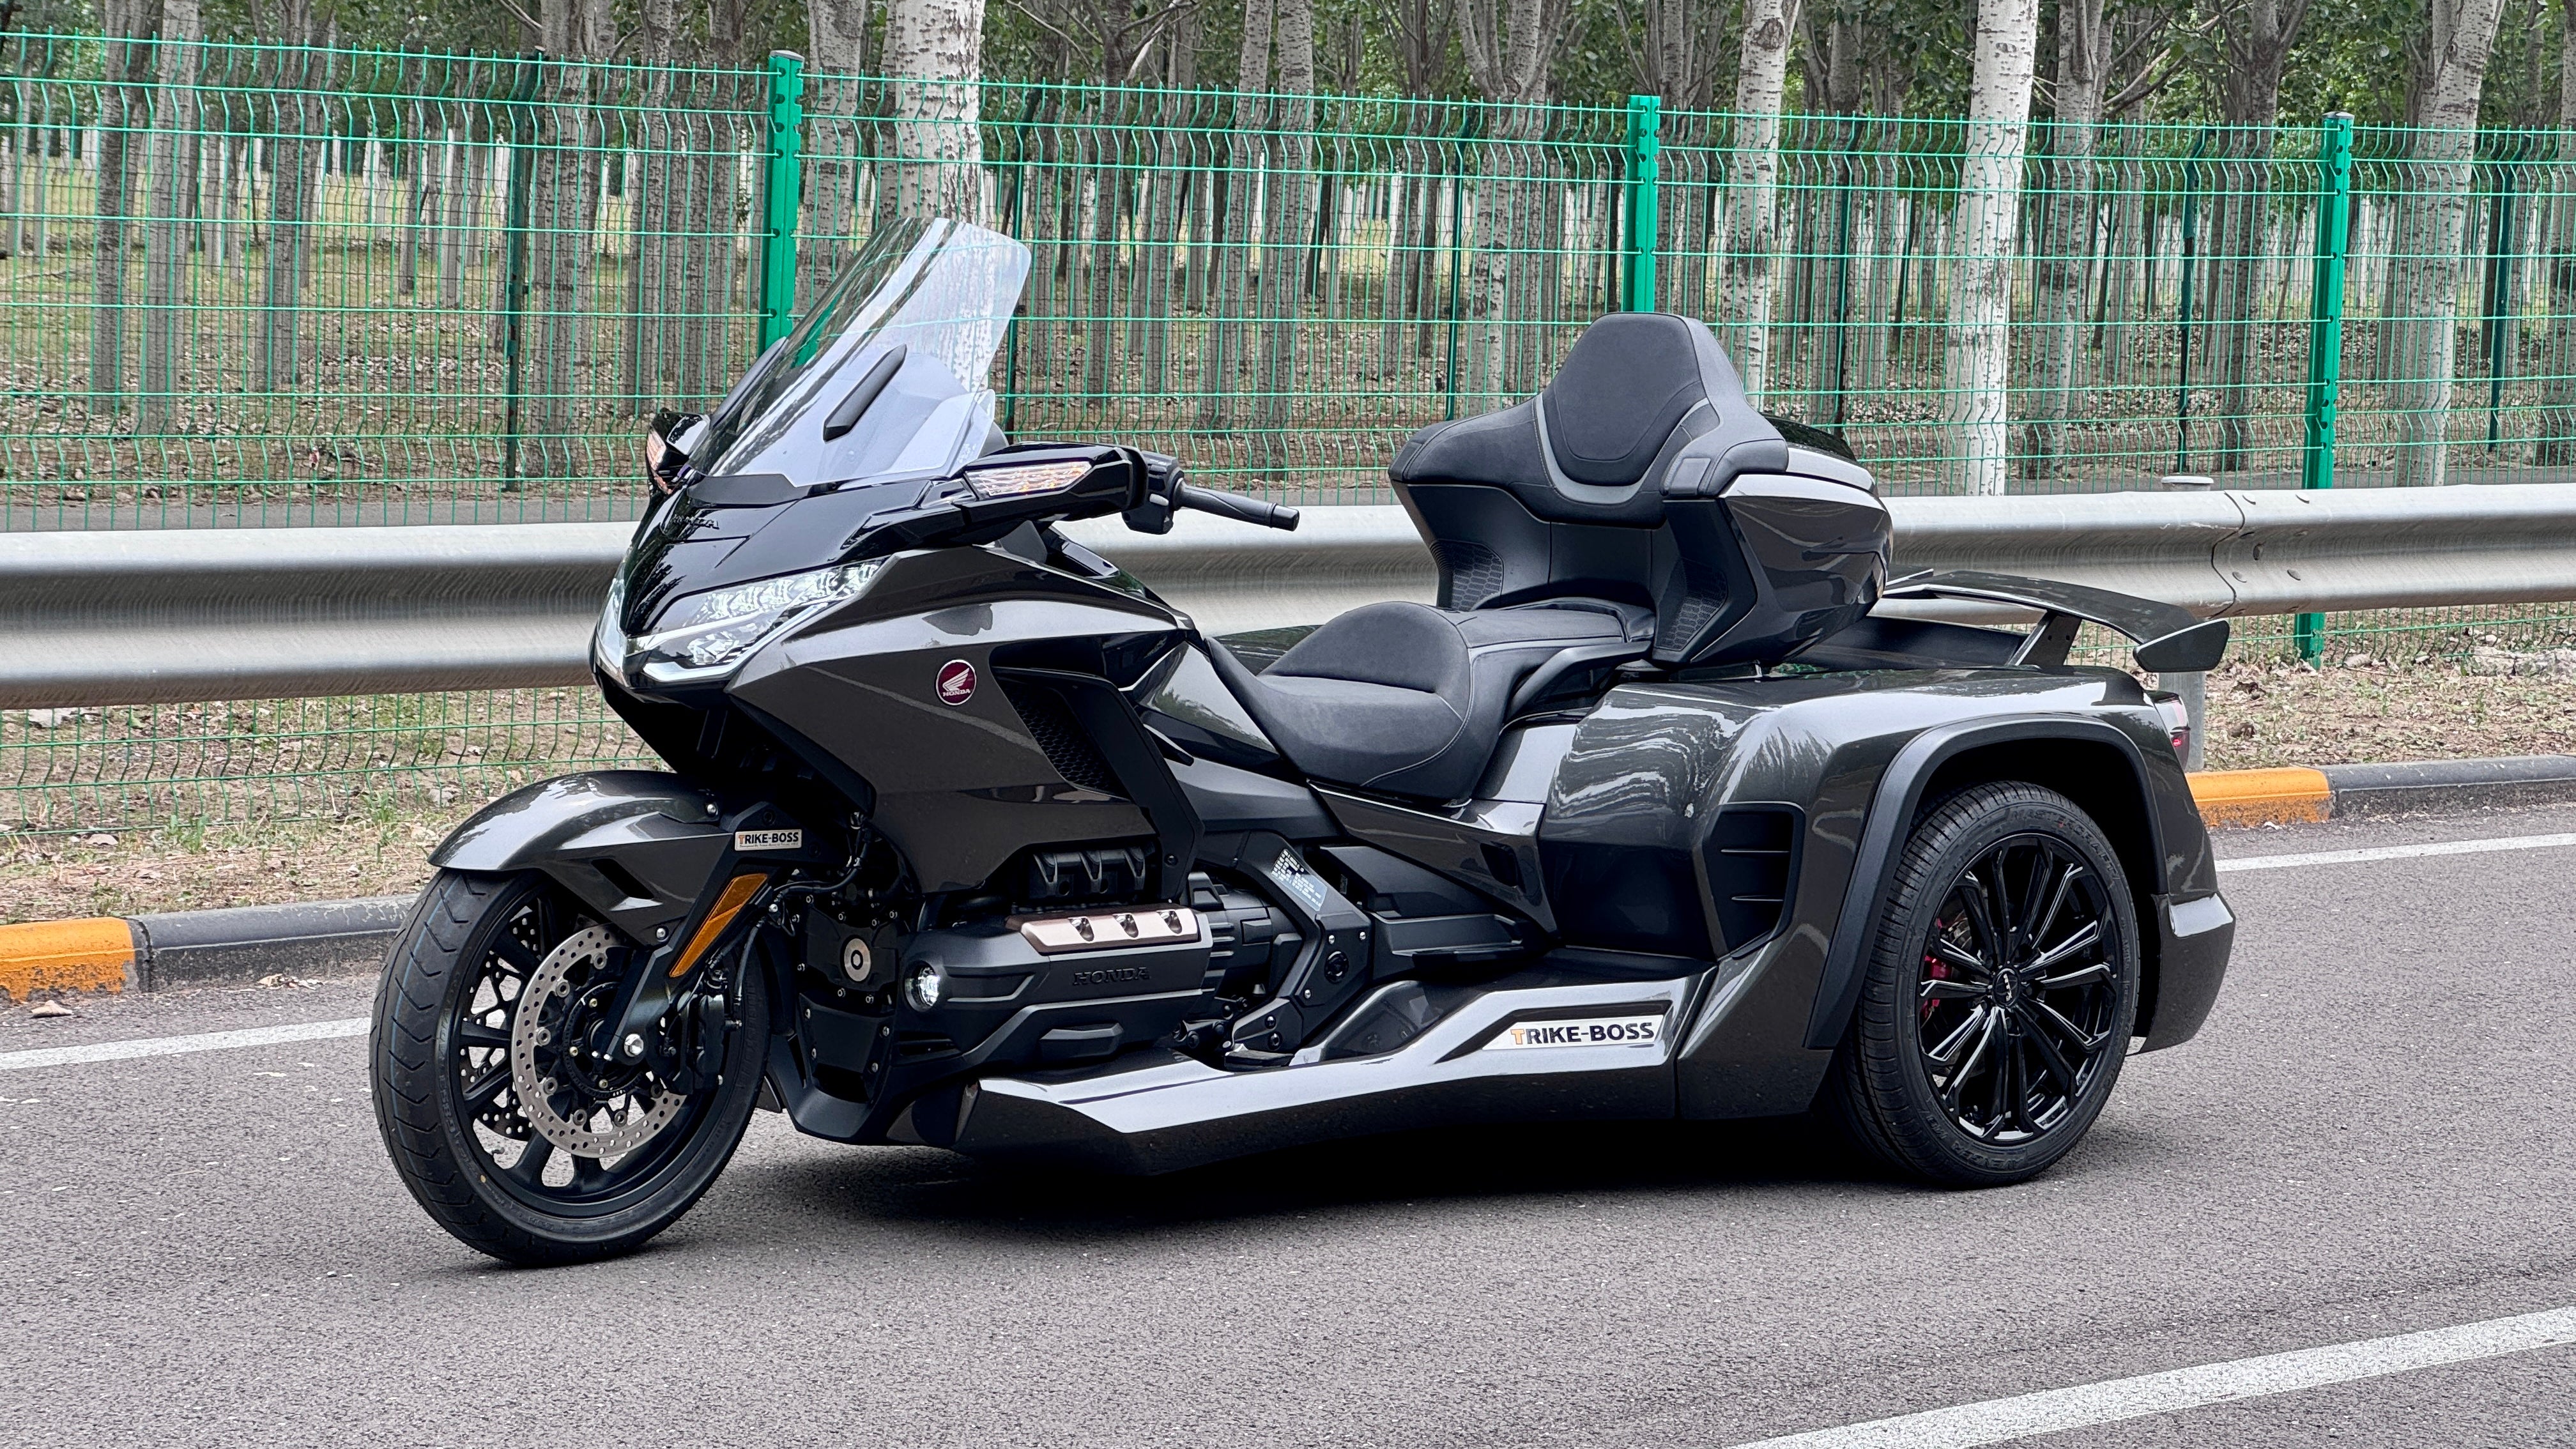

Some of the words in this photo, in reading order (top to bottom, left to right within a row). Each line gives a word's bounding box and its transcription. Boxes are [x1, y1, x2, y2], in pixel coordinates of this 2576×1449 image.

[942, 689, 971, 697] HONDA
[739, 832, 799, 844] TRIKE-BOSS
[1073, 967, 1151, 985] HONDA
[1510, 1022, 1655, 1045] TRIKE-BOSS
